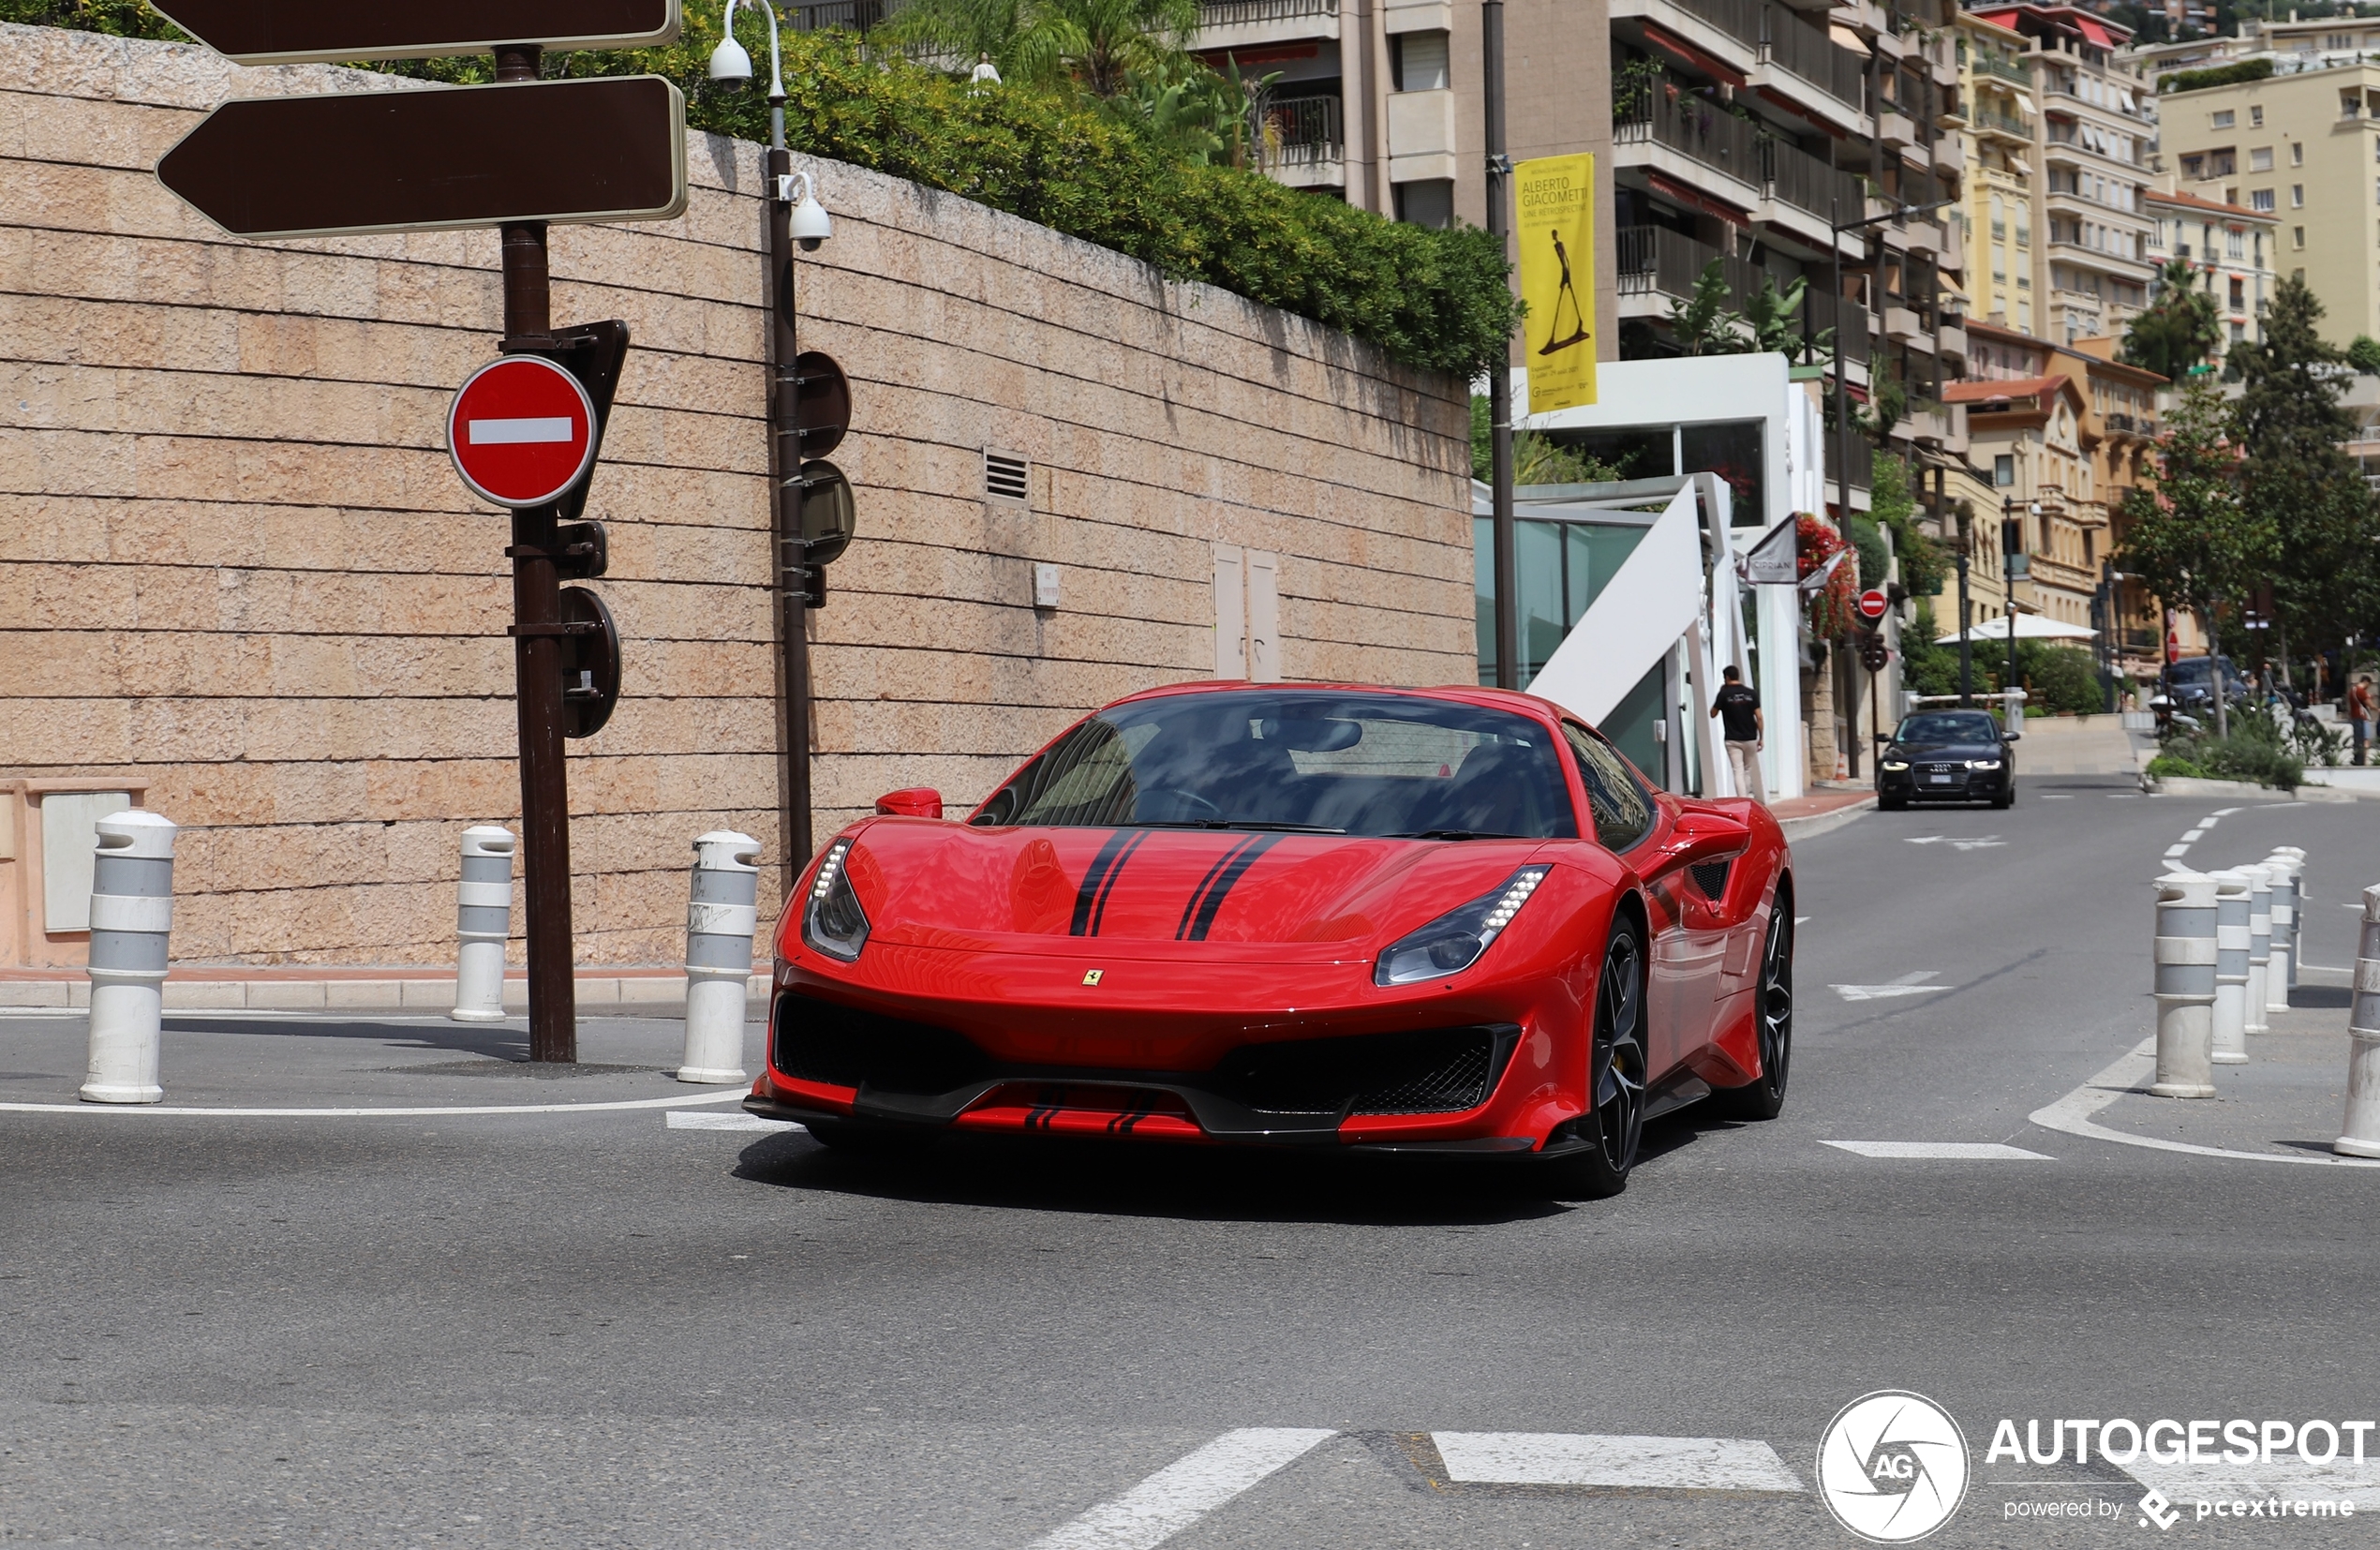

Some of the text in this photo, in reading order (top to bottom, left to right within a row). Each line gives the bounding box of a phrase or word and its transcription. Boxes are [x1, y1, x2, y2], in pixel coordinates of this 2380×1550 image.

[1523, 176, 1569, 194] ALBERTO
[1523, 187, 1587, 206] GIACOMETTI
[1524, 209, 1537, 218] UNE
